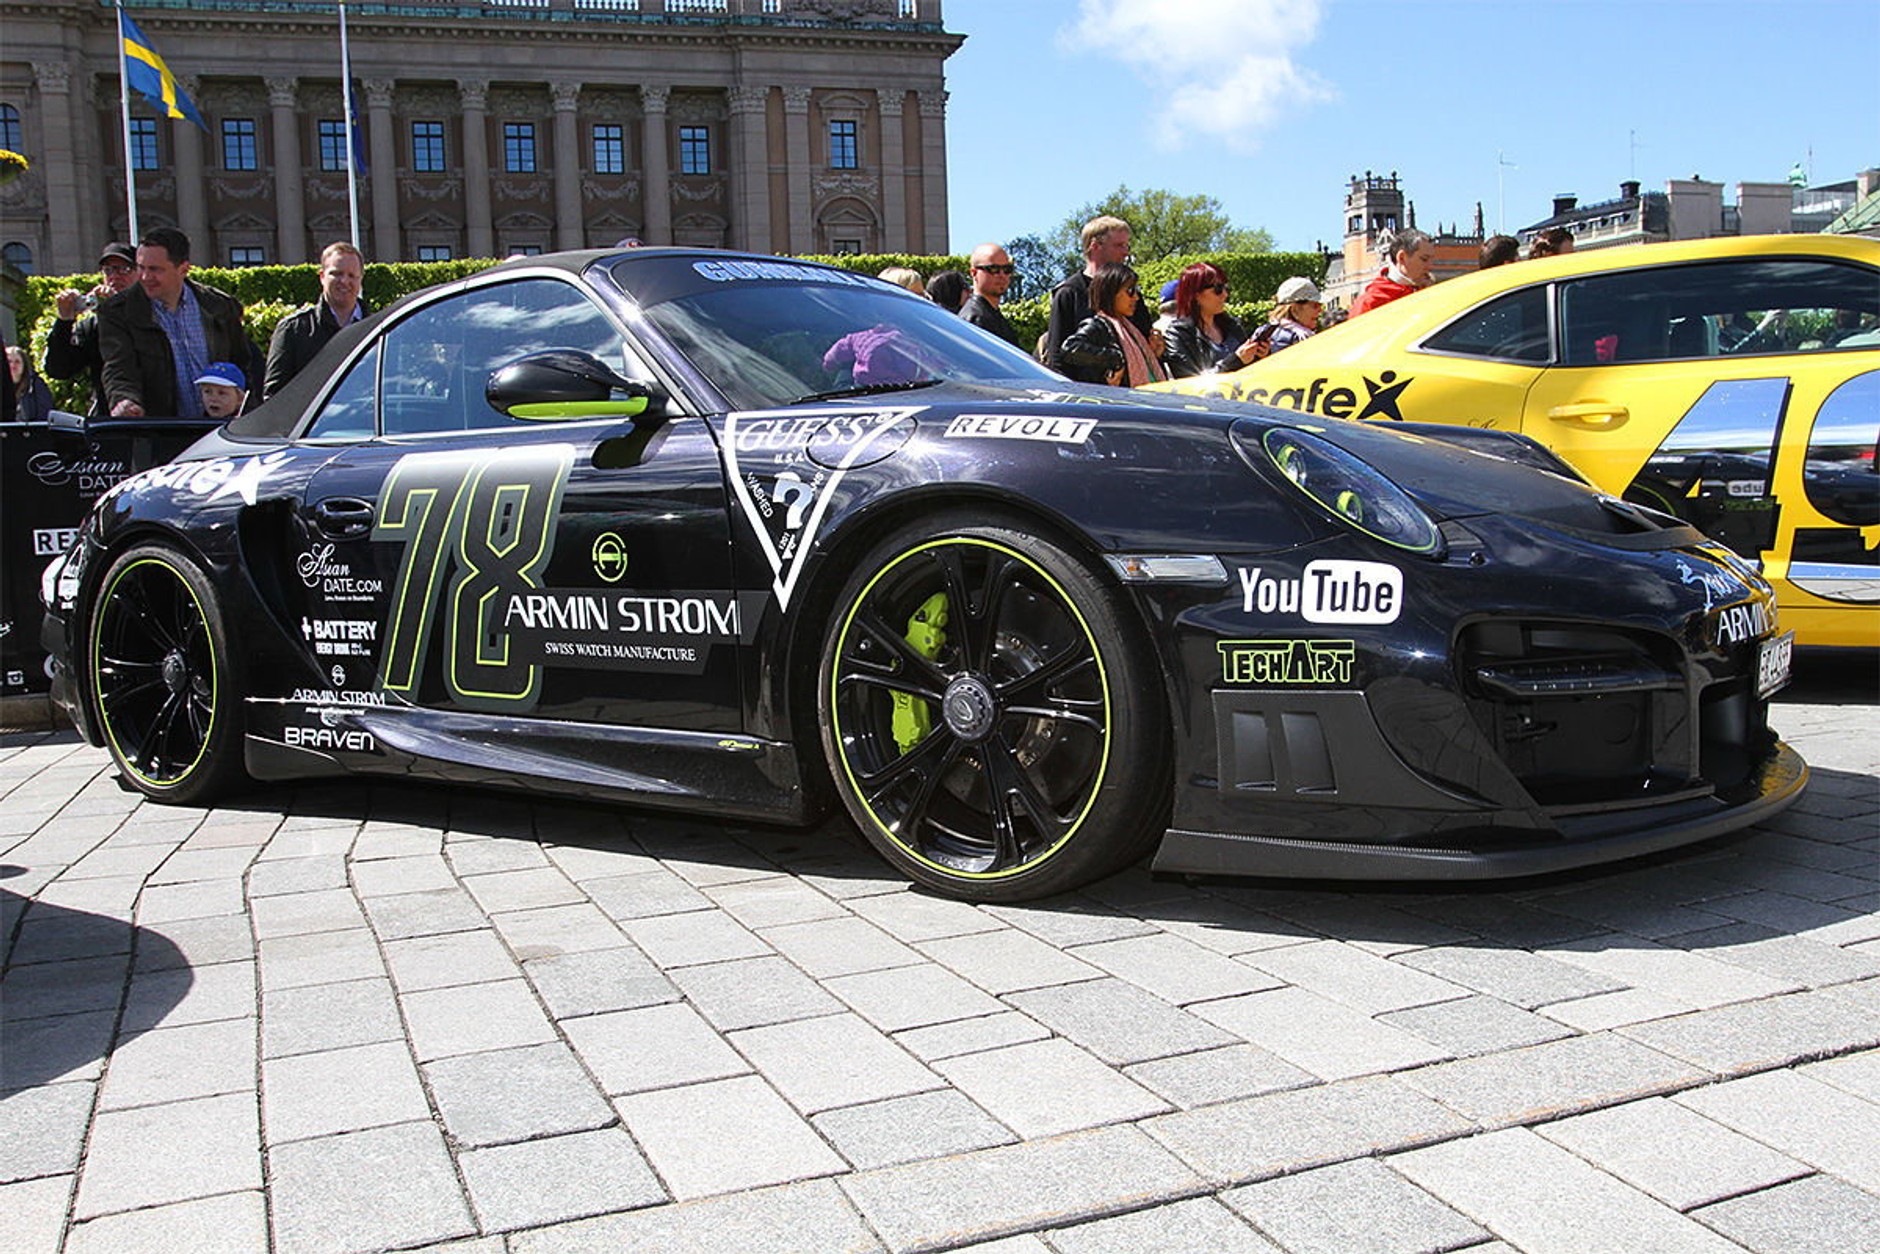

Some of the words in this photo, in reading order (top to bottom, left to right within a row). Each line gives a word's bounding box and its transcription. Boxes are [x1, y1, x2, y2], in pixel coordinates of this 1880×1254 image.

[737, 416, 872, 452] GUESS
[951, 416, 1092, 440] REVOLT
[747, 471, 774, 518] WASHED
[324, 578, 383, 593] DATE.COM
[370, 443, 575, 712] 78
[1238, 563, 1398, 618] YouTube
[313, 620, 377, 640] BATTERY
[505, 595, 609, 630] ARMIN
[617, 597, 742, 635] STROM
[1716, 602, 1769, 646] ARMIN
[545, 642, 574, 655] SWISS
[576, 644, 611, 658] WATCH
[613, 646, 697, 661] MANUFACTURE
[1218, 640, 1355, 682] TECHART
[291, 688, 338, 703] ARMIN
[341, 691, 385, 706] STROM
